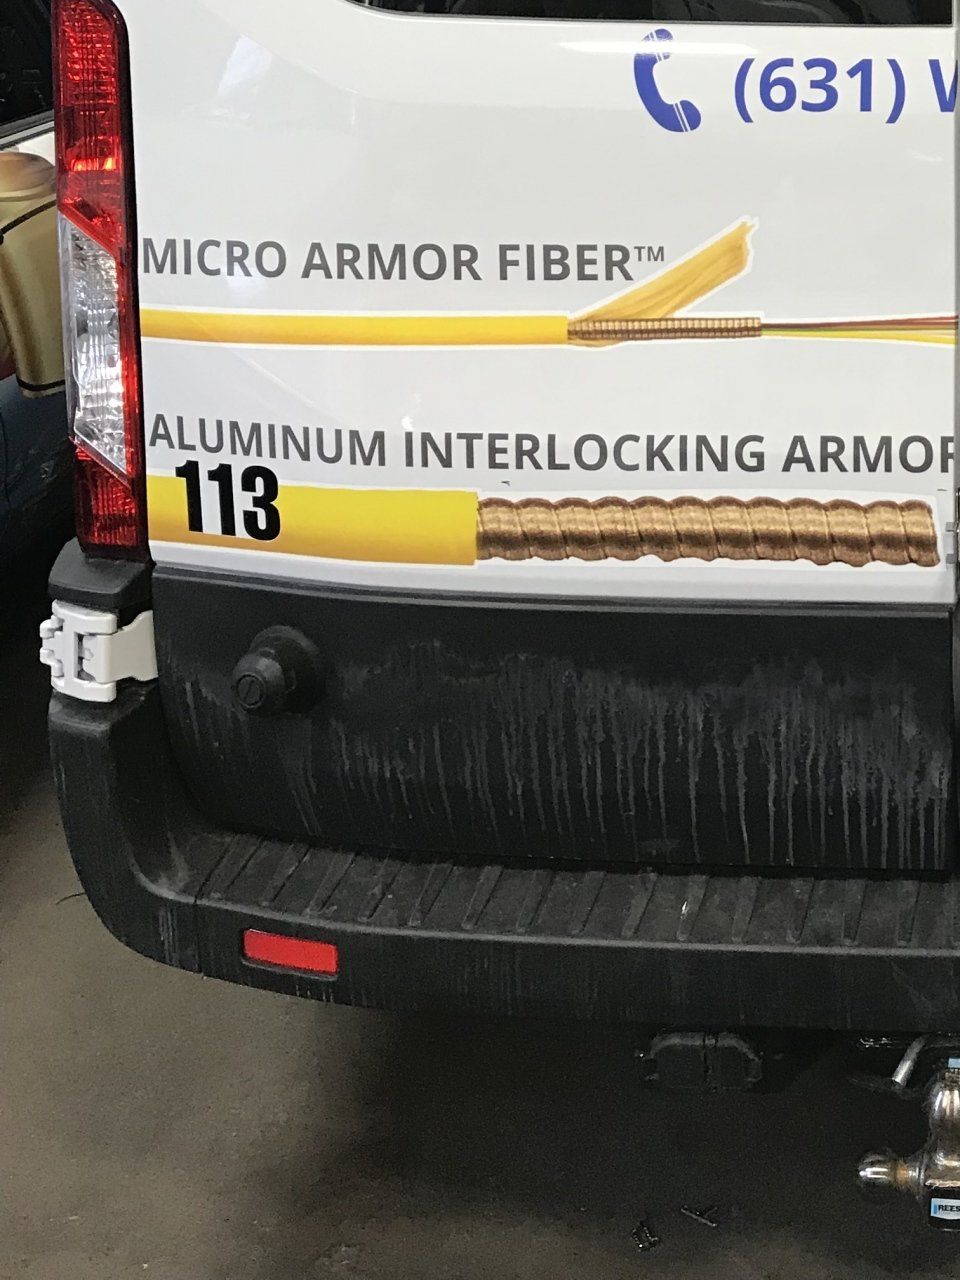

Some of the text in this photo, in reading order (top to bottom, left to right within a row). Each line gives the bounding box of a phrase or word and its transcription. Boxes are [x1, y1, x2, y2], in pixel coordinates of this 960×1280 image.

[734, 57, 907, 124] (631)
[143, 238, 287, 279] MICRO
[301, 243, 483, 281] ARMOR
[149, 413, 387, 468] ALUMINUM
[404, 431, 766, 474] INTERLOCKING
[174, 459, 282, 542] 113
